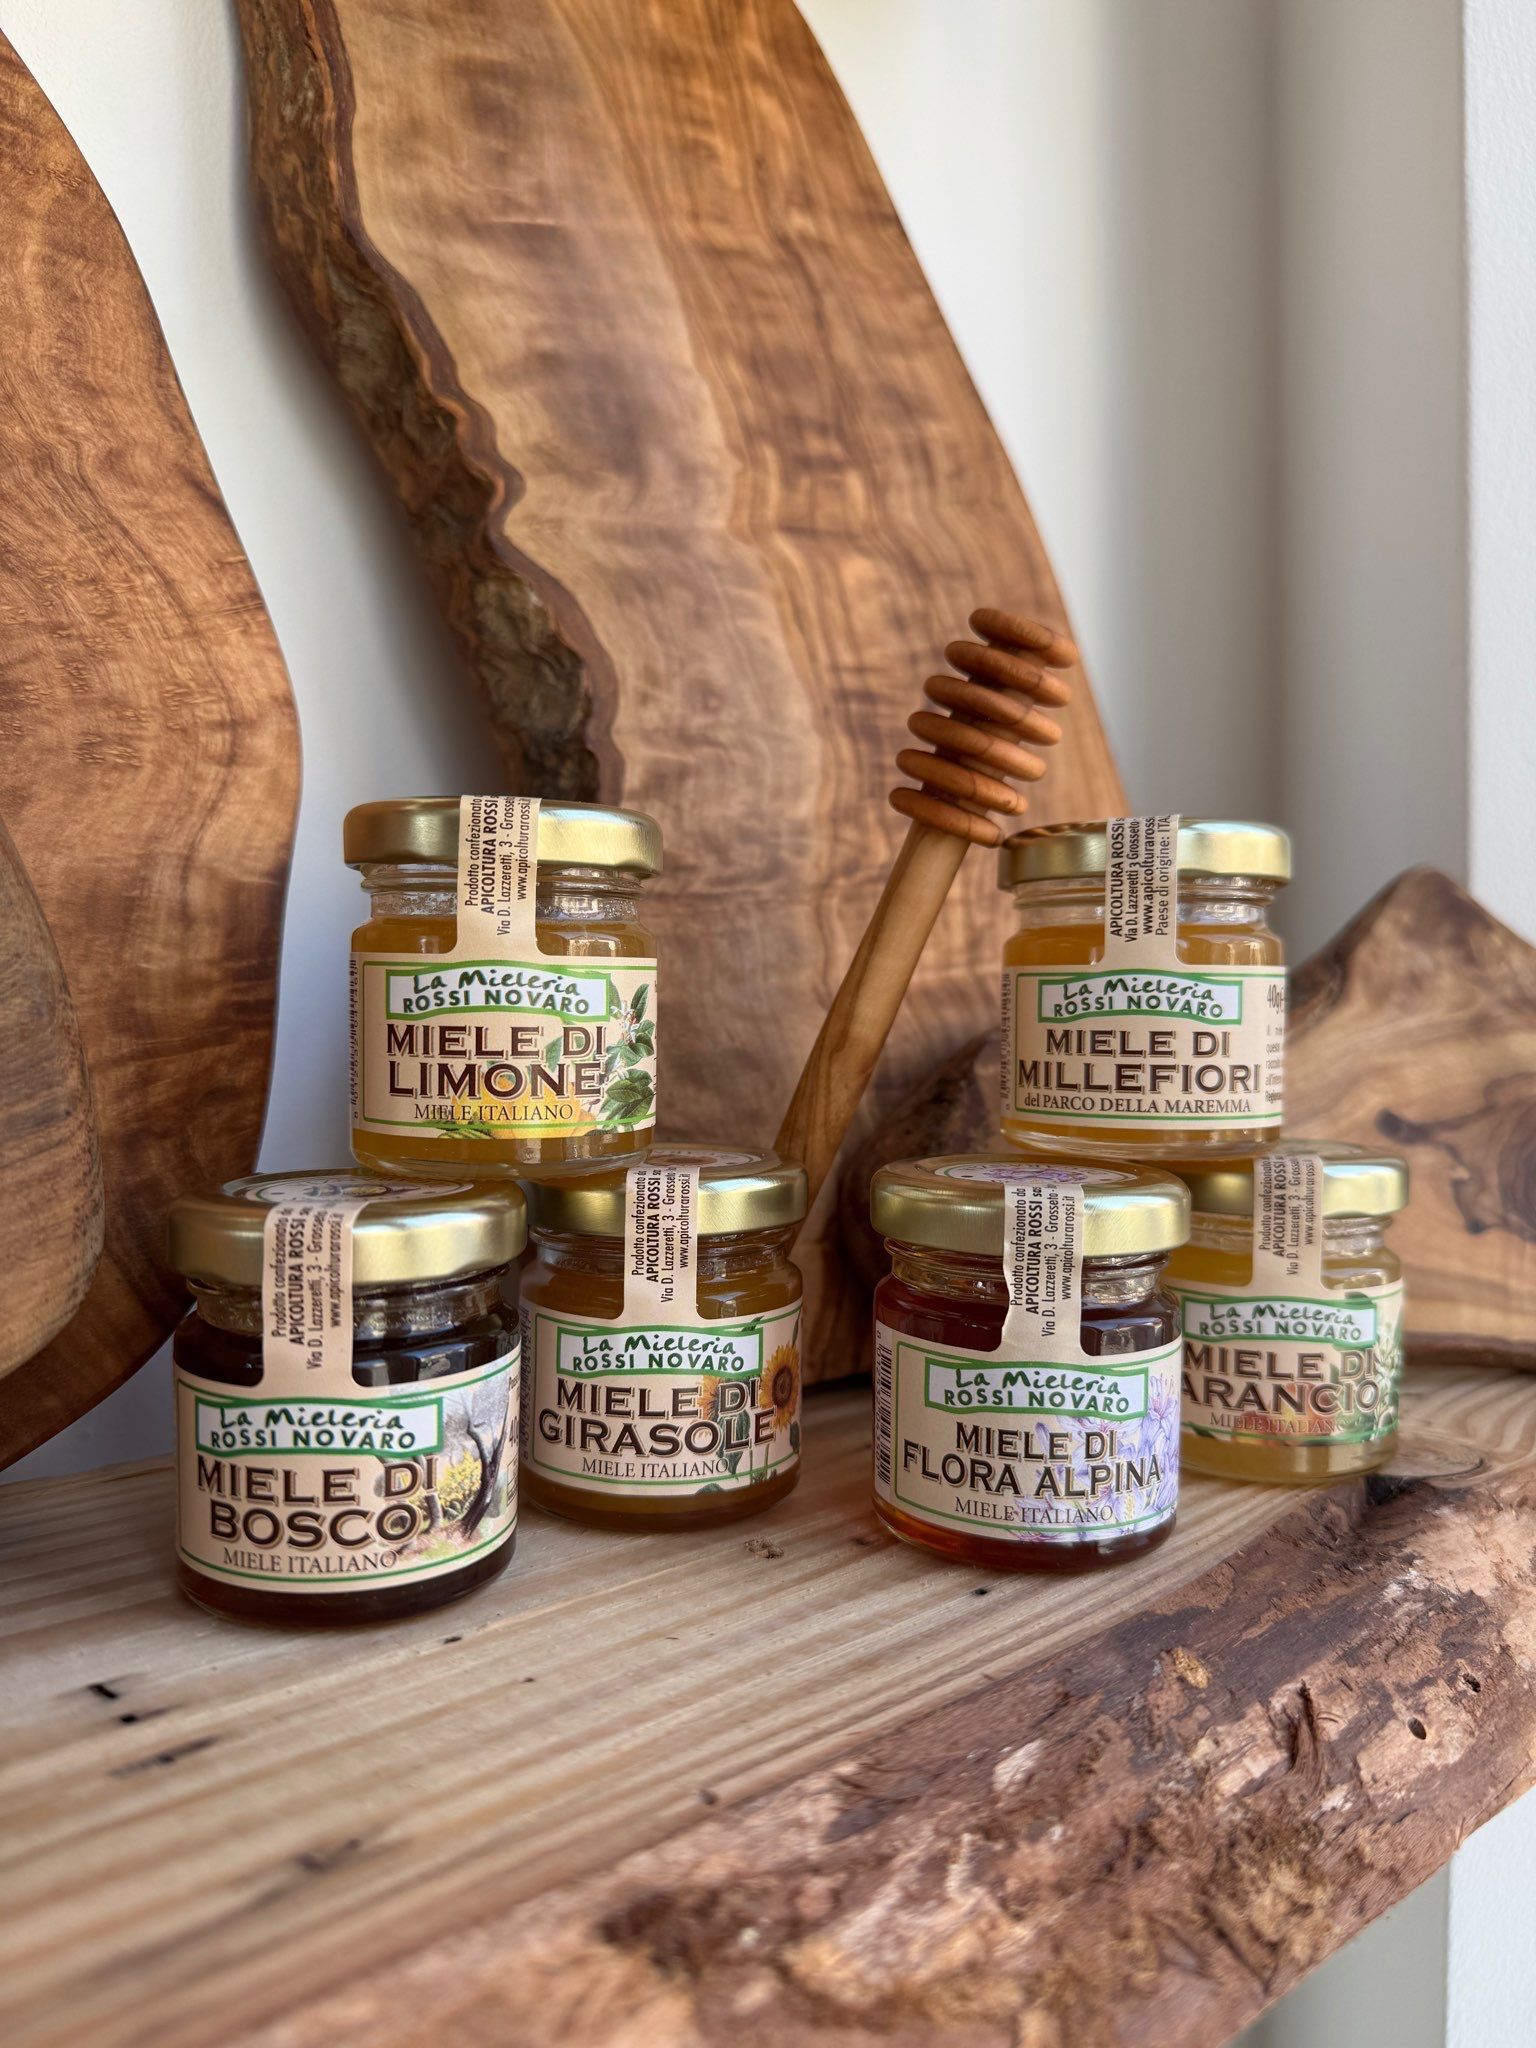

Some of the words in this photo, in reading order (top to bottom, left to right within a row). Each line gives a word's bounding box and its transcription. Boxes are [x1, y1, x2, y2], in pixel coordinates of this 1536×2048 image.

[466, 798, 482, 861] confezionato
[483, 799, 499, 834] ROSSI
[499, 840, 513, 848] 3
[1111, 823, 1124, 859] ROSSI
[1127, 821, 1139, 862] Grosseto
[481, 838, 497, 914] APICOLTURA
[1156, 836, 1172, 883] origine:
[464, 864, 479, 906] Prodotto
[1110, 861, 1124, 937] APICOLTURA
[1125, 870, 1138, 914] Lazzeretti
[1156, 886, 1168, 896] di
[497, 906, 510, 920] D.
[497, 921, 511, 936] Via
[1125, 917, 1138, 927] D.
[1155, 900, 1168, 936] Paese
[1124, 928, 1137, 942] Via
[412, 972, 446, 994] La
[458, 969, 581, 997] Mieleria
[1063, 980, 1092, 1000] La
[1103, 977, 1214, 1002] Mieleria
[402, 989, 470, 1014] ROSSI
[485, 989, 590, 1015] NOVARO
[1053, 996, 1113, 1018] ROSSI
[1127, 996, 1223, 1019] NOVARO
[386, 1023, 545, 1058] MIELE
[562, 1025, 607, 1058] DI
[1046, 1029, 1175, 1058] MIELE
[1192, 1031, 1230, 1058] DI
[388, 1061, 605, 1100] LIMONE
[1018, 1059, 1261, 1094] MILLEFIORI
[414, 1103, 472, 1121] MIELE
[478, 1104, 573, 1121] ITALIANO
[1024, 1092, 1040, 1107] del
[1042, 1094, 1095, 1112] PARCO
[1099, 1097, 1160, 1113] DELLA
[1164, 1099, 1252, 1113] MAREMMA
[1273, 1161, 1286, 1190] ROSSI
[631, 1176, 646, 1235] confezionato
[647, 1177, 661, 1210] ROSSI
[1011, 1188, 1026, 1197] da
[1028, 1200, 1043, 1237] ROSSI
[1045, 1192, 1059, 1232] Grosseto
[1273, 1194, 1286, 1257] APICOLTURA
[289, 1218, 306, 1259] ROSSI
[661, 1224, 677, 1270] Lazzeretti,
[1011, 1199, 1026, 1262] confezionato
[631, 1237, 644, 1276] Prodotto
[646, 1213, 660, 1283] APICOLTURA
[1059, 1195, 1076, 1300] www.apicolturarossi.it
[1286, 1250, 1299, 1259] D.
[307, 1264, 322, 1273] 3
[661, 1274, 674, 1285] D.
[1026, 1241, 1042, 1315] APICOLTURA
[1042, 1253, 1059, 1302] Lazzeretti,
[1286, 1262, 1298, 1275] Via
[661, 1287, 674, 1303] Via
[1010, 1265, 1023, 1306] Prodotto
[270, 1290, 287, 1338] Prodotto
[288, 1264, 305, 1345] APICOLTURA
[1042, 1306, 1055, 1318] D.
[1209, 1303, 1240, 1320] La
[1252, 1304, 1354, 1325] Mieleria
[307, 1336, 323, 1348] D.
[582, 1335, 613, 1354] La
[625, 1332, 735, 1355] Mieleria
[1042, 1321, 1055, 1337] Via
[1199, 1319, 1262, 1336] ROSSI
[1275, 1321, 1362, 1341] NOVARO
[306, 1351, 322, 1370] Via
[573, 1353, 635, 1372] ROSSI
[648, 1354, 744, 1372] NOVARO
[1183, 1343, 1324, 1381] MIELE
[1339, 1350, 1377, 1380] DI
[556, 1378, 708, 1418] MIELE
[717, 1376, 760, 1415] DI
[955, 1368, 990, 1389] La
[1002, 1369, 1120, 1395] Mieleria
[1181, 1374, 1382, 1415] ARANCIO
[220, 1406, 252, 1428] La
[265, 1405, 403, 1430] Mieleria
[944, 1389, 1013, 1408] ROSSI
[1029, 1391, 1129, 1413] NOVARO
[539, 1408, 776, 1458] GIRASOLE
[1209, 1413, 1265, 1432] MIELE
[210, 1429, 277, 1450] ROSSI
[293, 1430, 416, 1449] NOVARO
[955, 1421, 1074, 1462] MIELE
[1084, 1429, 1117, 1462] DI
[196, 1454, 358, 1505] MIELE
[383, 1455, 439, 1498] DI
[581, 1457, 635, 1478] MIELE
[640, 1457, 728, 1478] ITALIANO
[903, 1438, 1022, 1498] FLORA
[1033, 1455, 1163, 1500] ALPINA
[209, 1503, 422, 1550] BOSCO
[954, 1496, 1014, 1523] MIELE
[1017, 1504, 1114, 1524] ITALIANO
[223, 1548, 281, 1574] MIELE
[288, 1550, 400, 1575] ITALIANO
